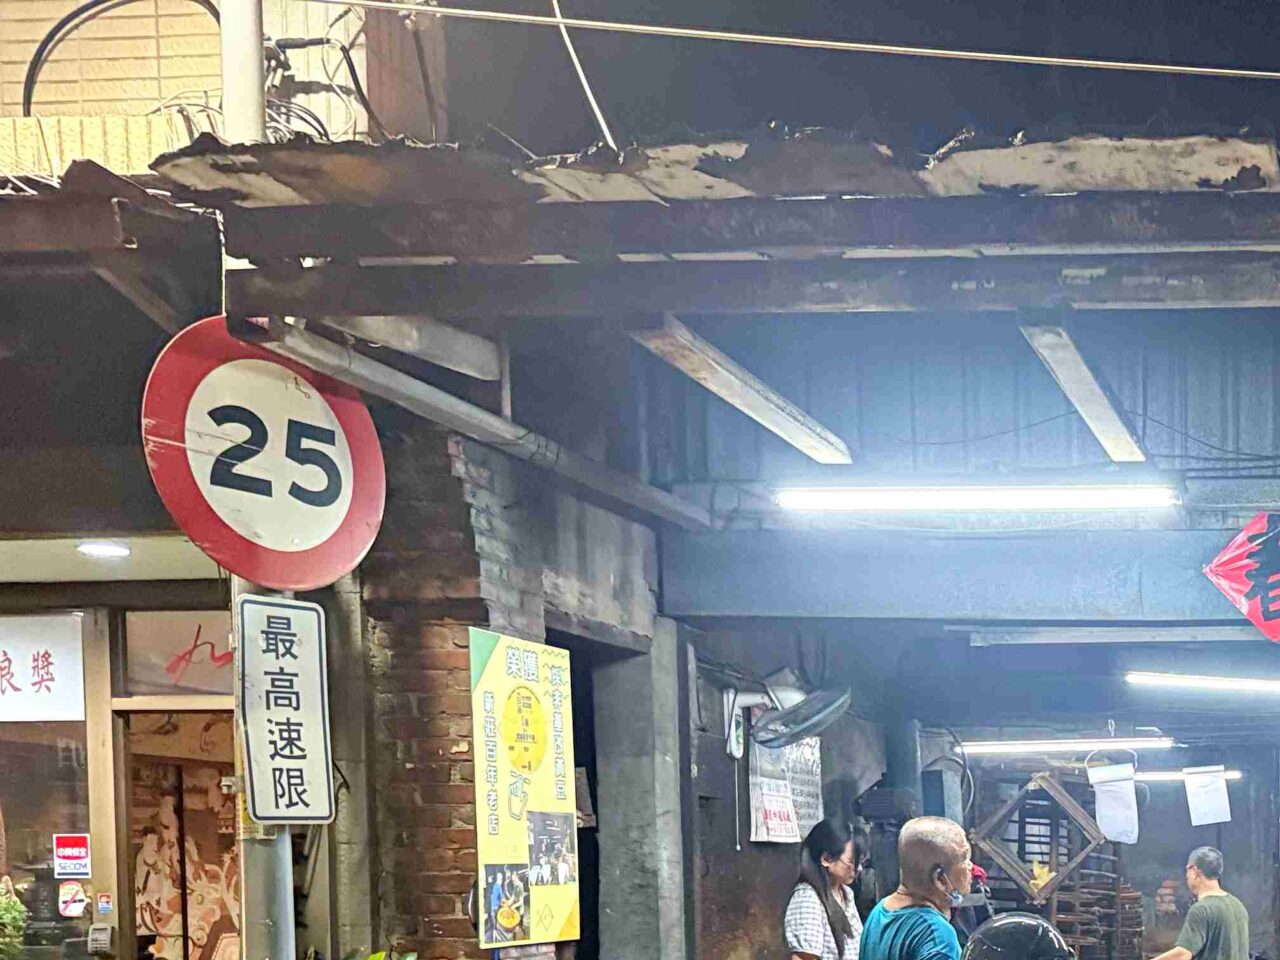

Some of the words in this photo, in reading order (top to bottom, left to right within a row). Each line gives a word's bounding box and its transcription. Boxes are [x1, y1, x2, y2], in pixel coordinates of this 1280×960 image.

[207, 405, 342, 507] 25
[506, 645, 539, 683] 榮獲
[260, 615, 311, 810] 最高速限
[58, 862, 88, 871] SECOM
